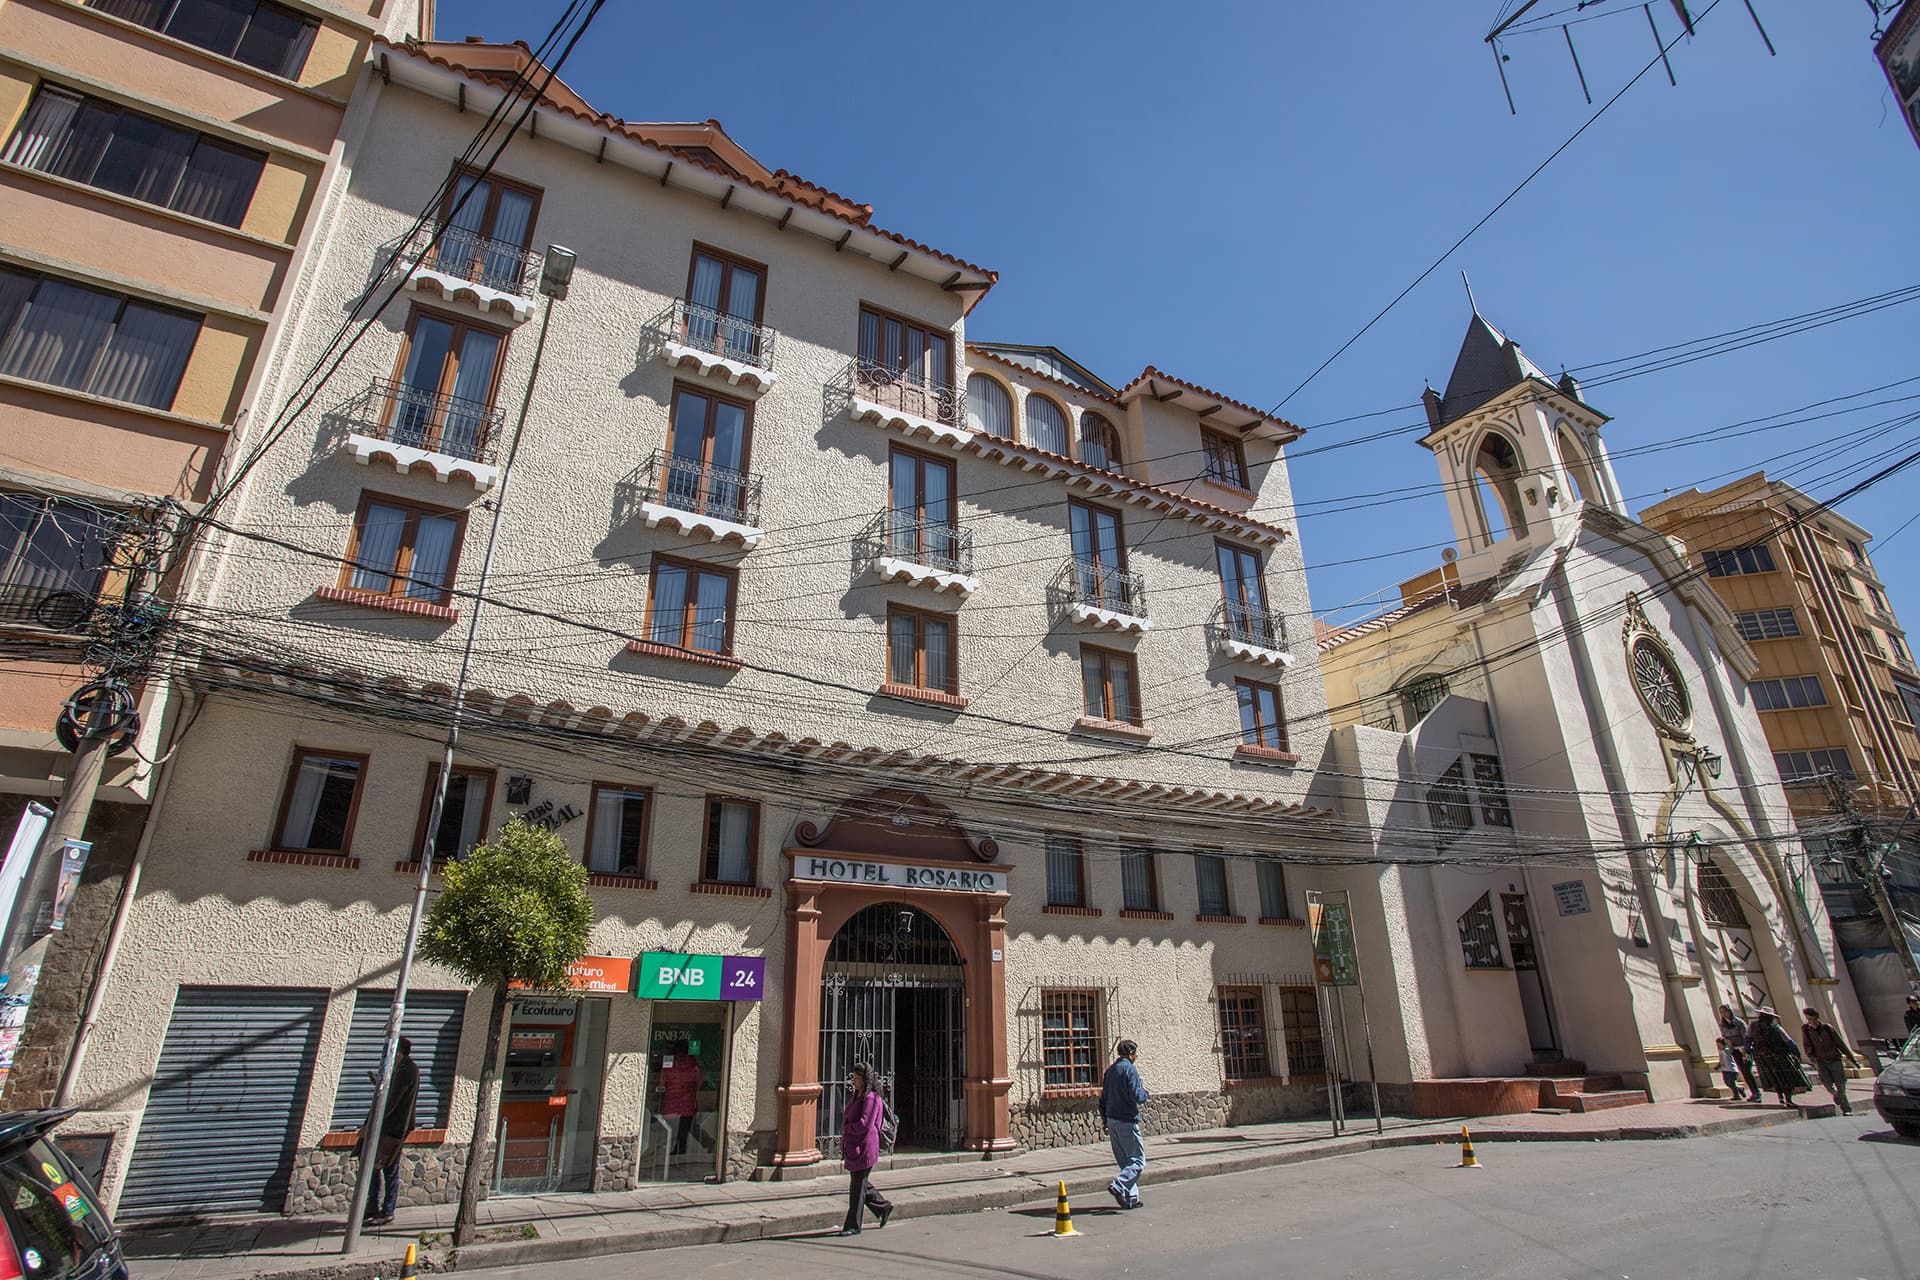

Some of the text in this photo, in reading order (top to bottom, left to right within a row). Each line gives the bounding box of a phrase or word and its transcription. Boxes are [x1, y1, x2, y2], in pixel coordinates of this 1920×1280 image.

[810, 859, 994, 889] HOTEL ROSARIO
[566, 965, 604, 977] futuro
[658, 967, 756, 987] BNB .24
[522, 1005, 574, 1016] Ecofuturo
[655, 1030, 678, 1041] BNB
